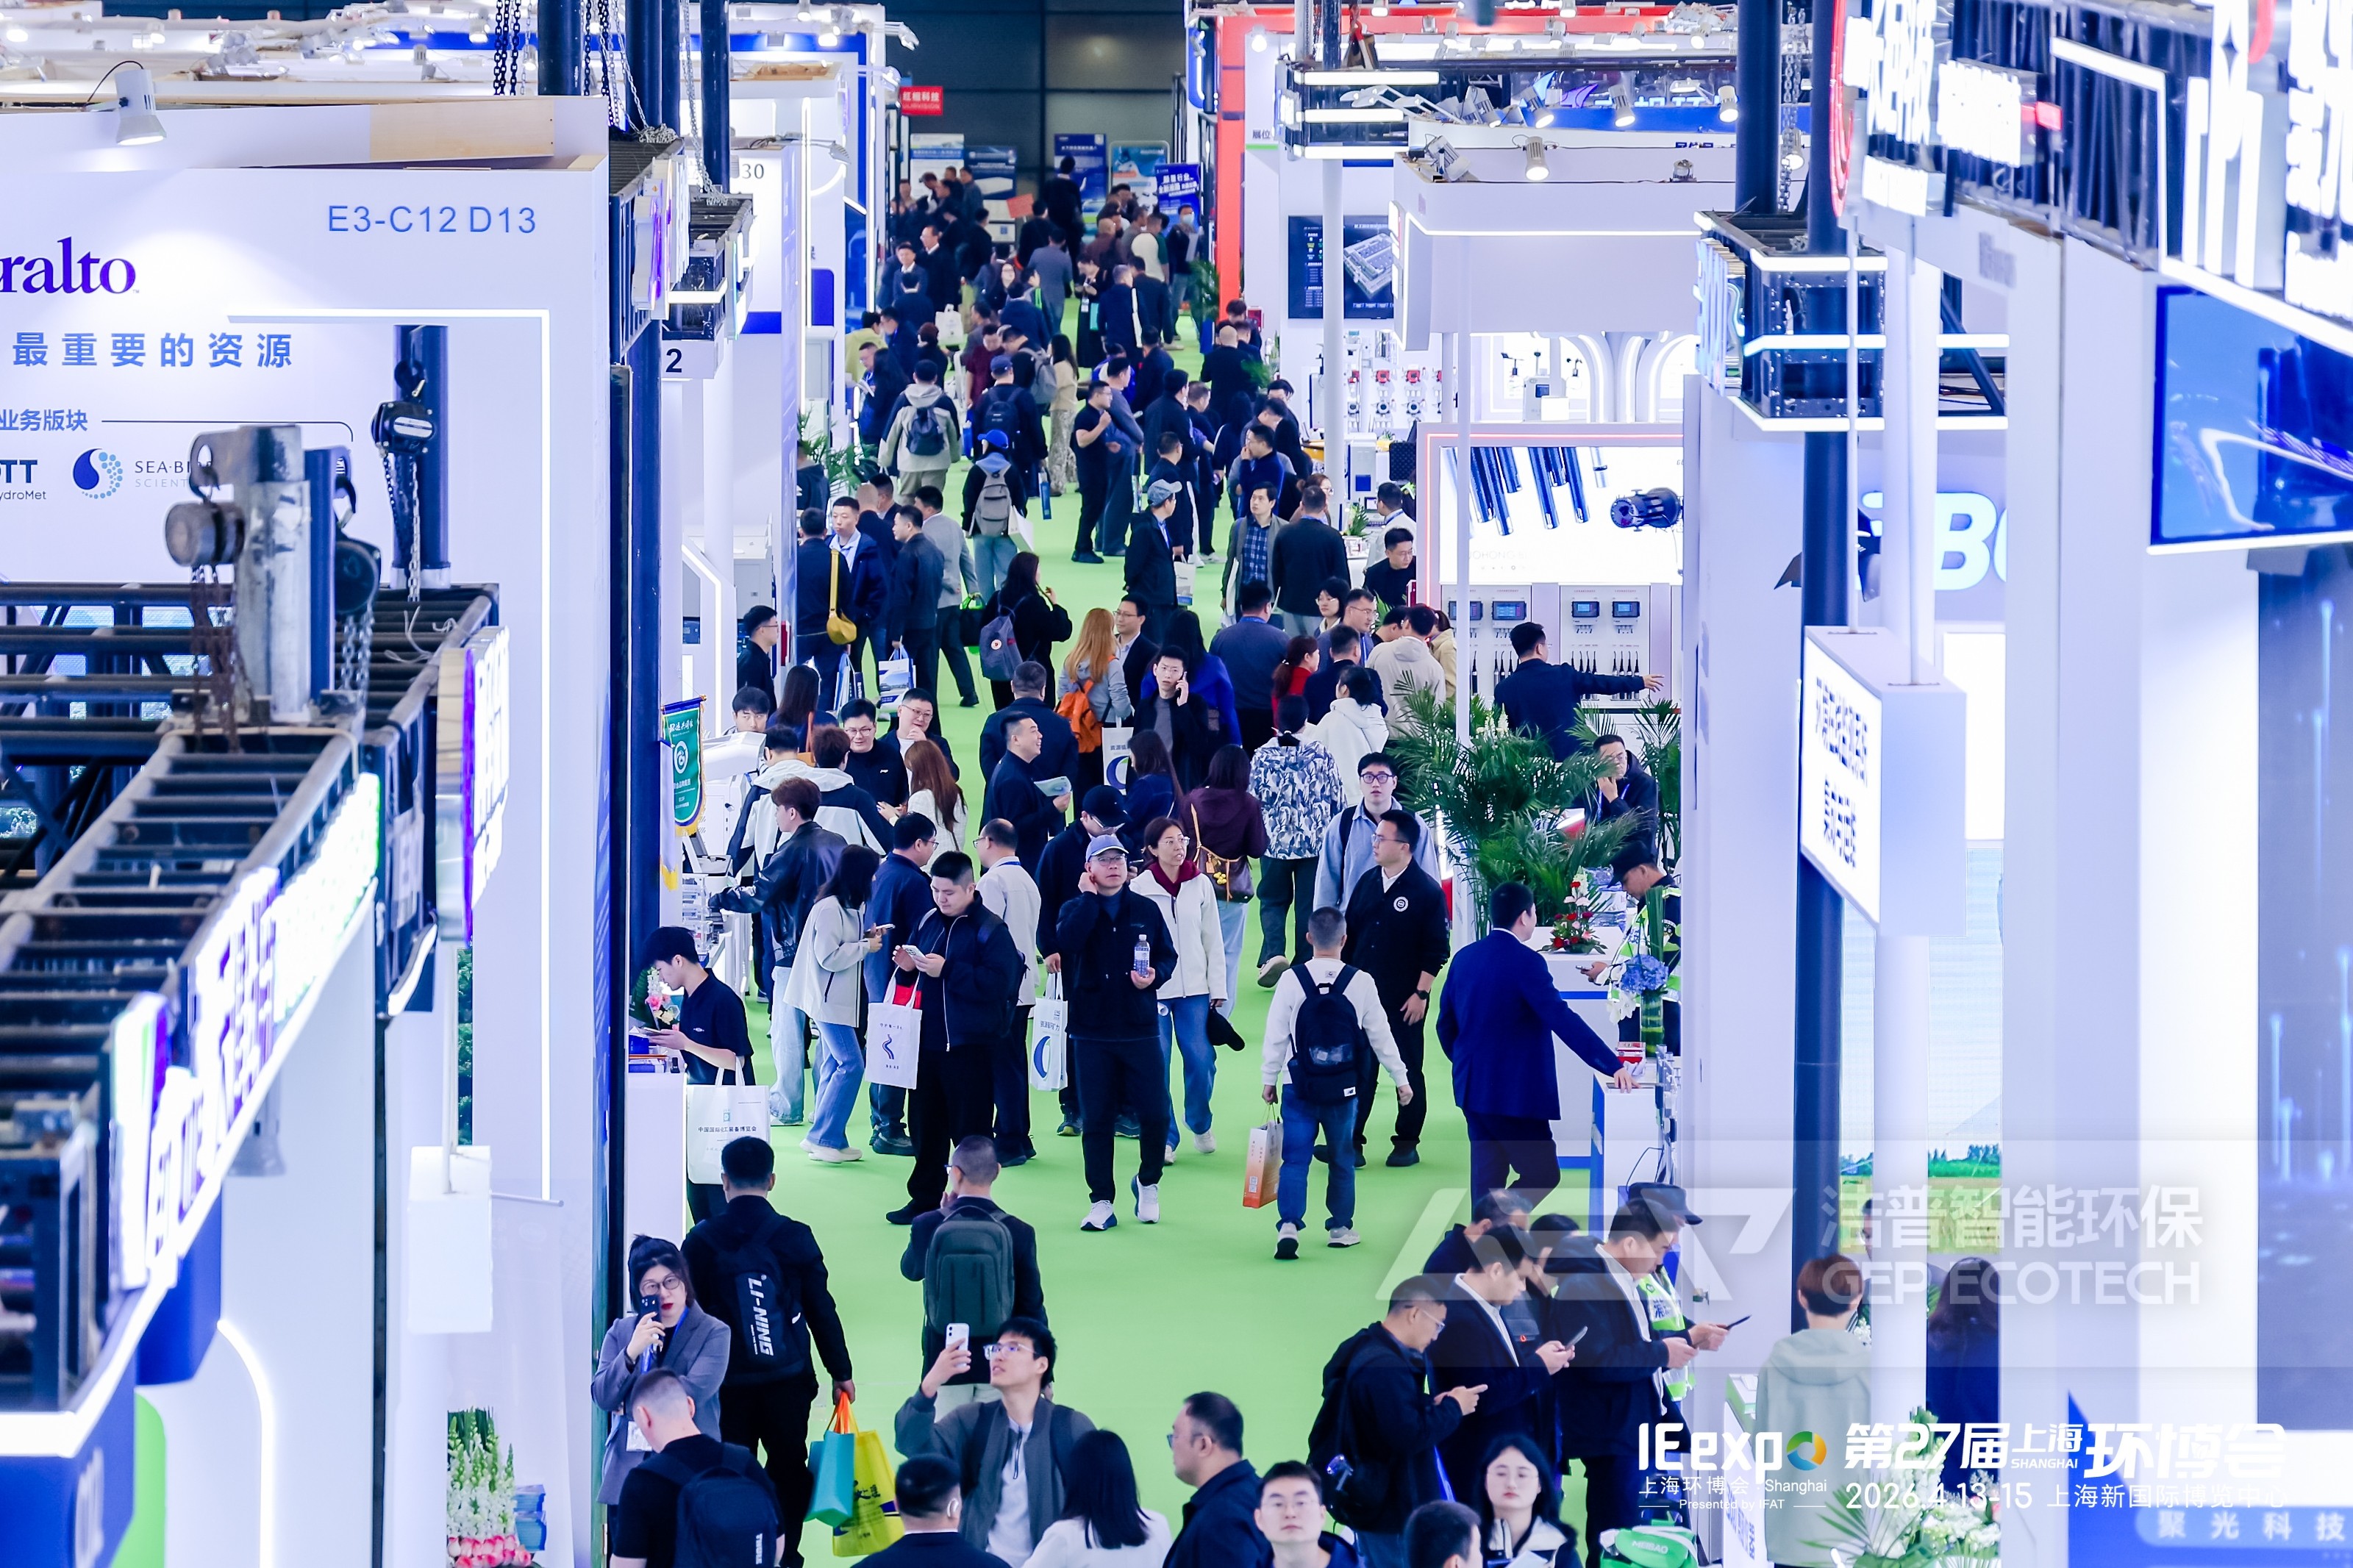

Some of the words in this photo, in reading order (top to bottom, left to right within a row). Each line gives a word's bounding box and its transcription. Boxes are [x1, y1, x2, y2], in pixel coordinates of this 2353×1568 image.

[329, 205, 457, 232] E3-C12
[469, 206, 536, 234] D13
[0, 237, 136, 294] ralto
[13, 332, 292, 368] 最重要的资源
[0, 409, 88, 432] 业务版块
[0, 459, 38, 483] TT
[135, 461, 212, 473] SEA·BI
[135, 479, 189, 487] SCIENT
[748, 1278, 774, 1356] LI-NING
[2157, 1509, 2346, 1542] 聚光科技
